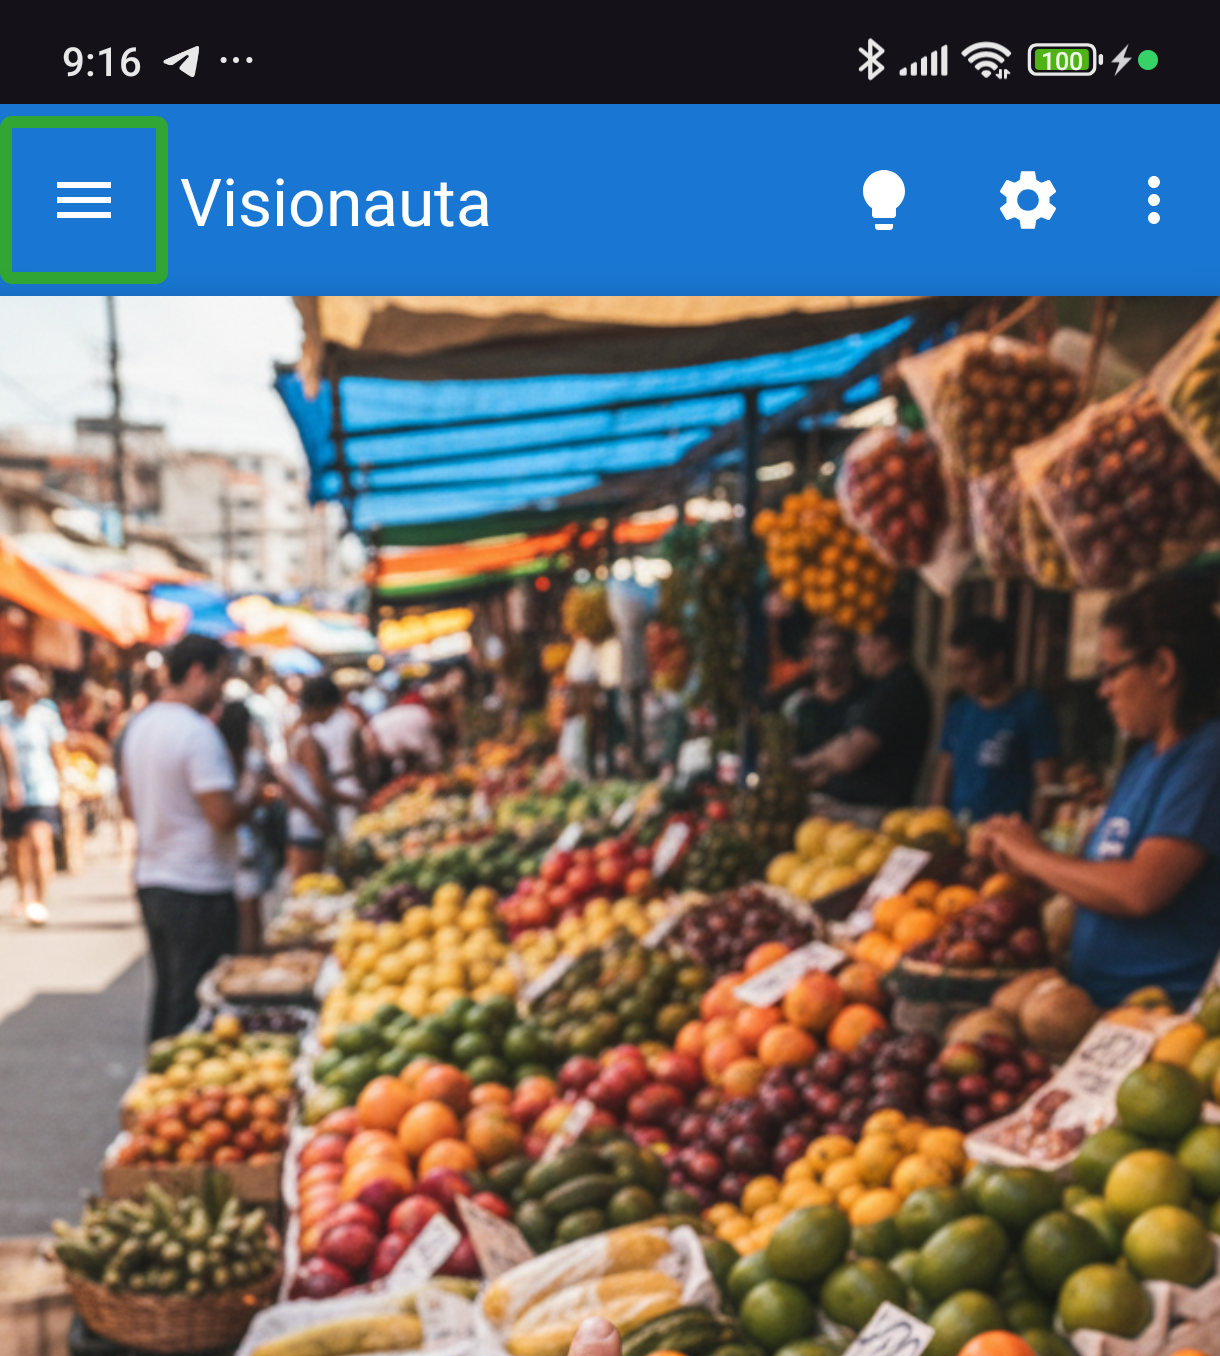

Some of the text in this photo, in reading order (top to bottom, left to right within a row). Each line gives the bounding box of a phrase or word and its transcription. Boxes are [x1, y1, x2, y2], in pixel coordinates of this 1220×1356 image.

[63, 47, 142, 78] 9:16
[1042, 51, 1083, 71] 100
[181, 178, 490, 228] Visionauta
